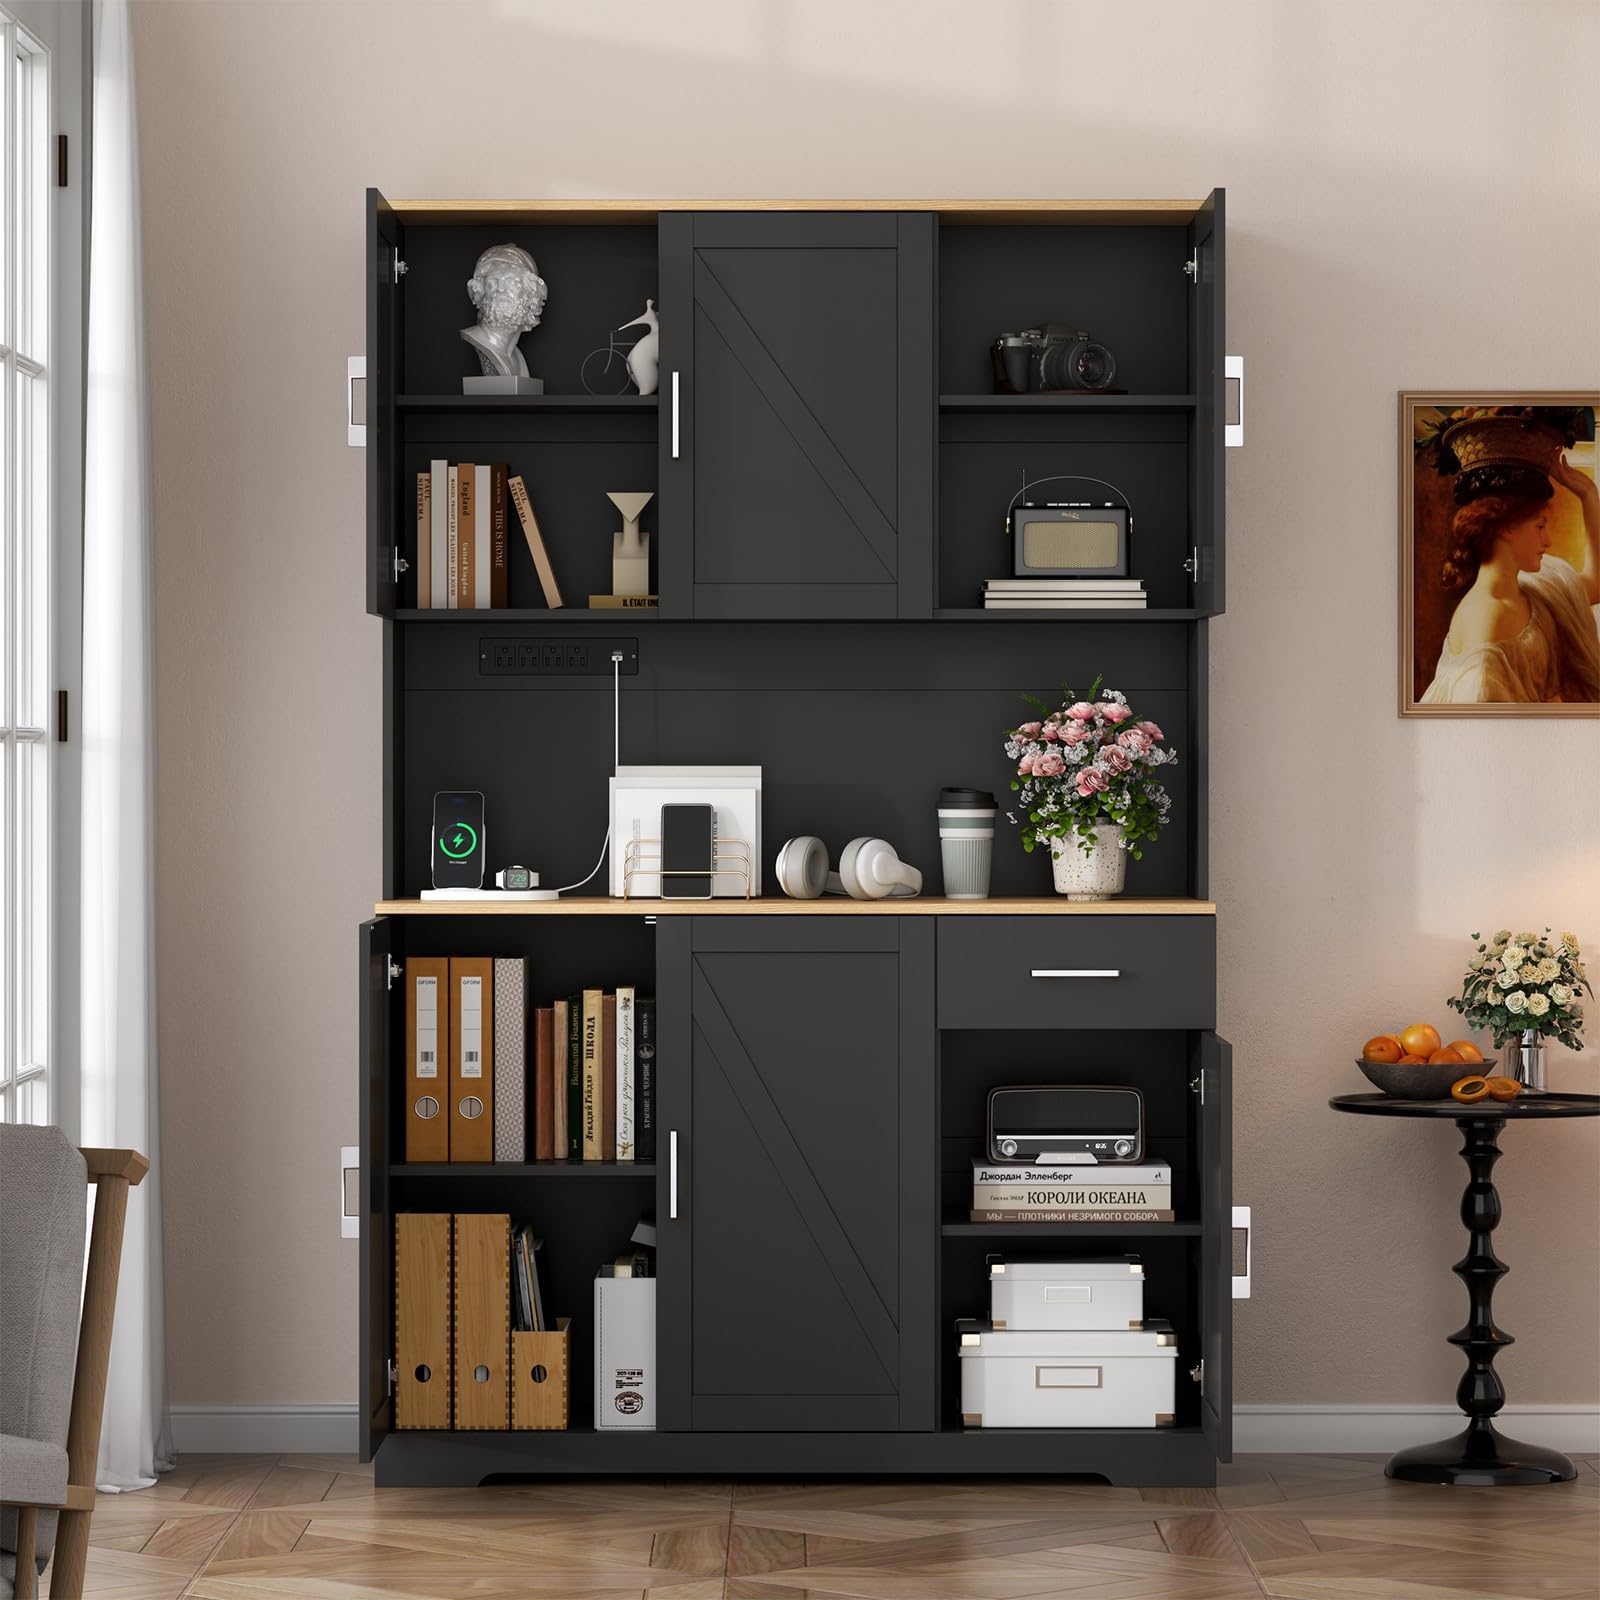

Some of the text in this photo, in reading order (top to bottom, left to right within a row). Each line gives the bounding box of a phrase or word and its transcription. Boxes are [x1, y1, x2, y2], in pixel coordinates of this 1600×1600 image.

[461, 481, 470, 516] England
[510, 483, 527, 524] SIETSEMA
[516, 481, 528, 503] PAUL
[495, 509, 503, 568] THIS IS HOME
[461, 566, 469, 597] Kingdom
[570, 1006, 579, 1086] Виталий Бианки
[586, 1016, 595, 1060] ШКОЛА
[619, 1104, 632, 1140] Сказки
[980, 1171, 1073, 1183] Джордан Элленберг
[1027, 1191, 1147, 1205] КОРОЛИ ОКЕАНА
[986, 1212, 1003, 1221] МЫ
[1017, 1212, 1066, 1221] ПЛОТНИКИ
[1068, 1212, 1122, 1221] НЕЗРИМОГО
[1123, 1212, 1160, 1221] СОБОРА
